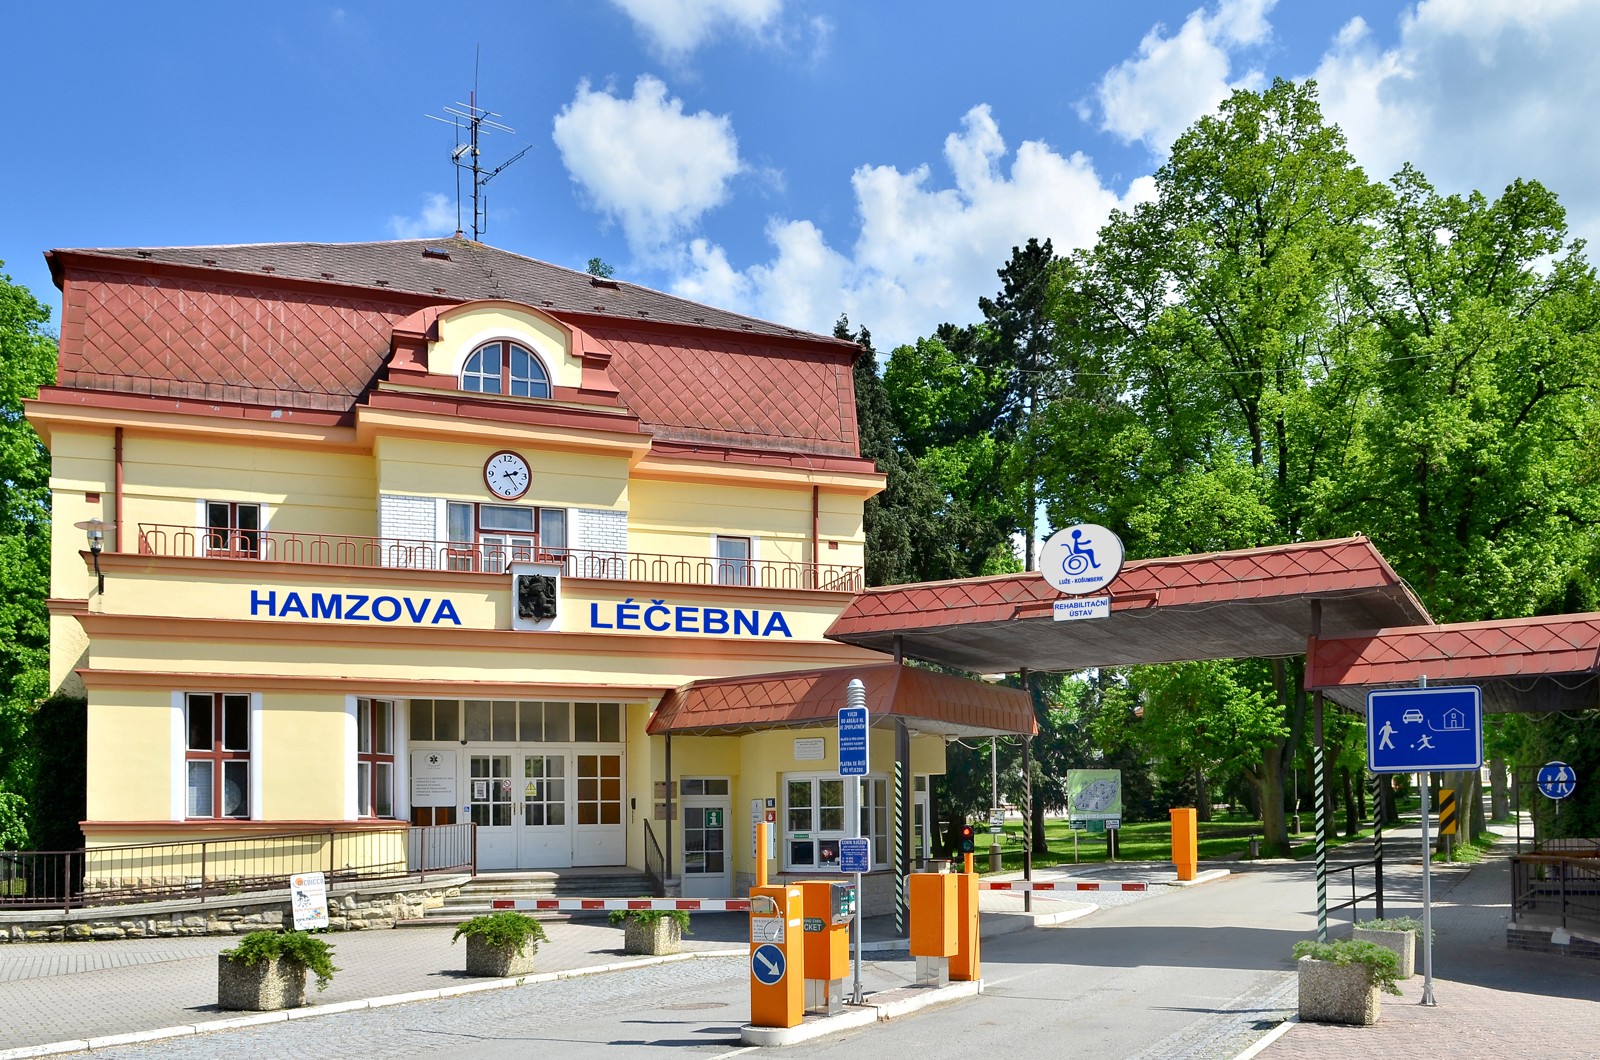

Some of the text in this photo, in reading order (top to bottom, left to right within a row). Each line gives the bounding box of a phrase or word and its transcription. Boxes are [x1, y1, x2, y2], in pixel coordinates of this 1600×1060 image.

[1054, 599, 1108, 610] REHABILITAČNÍ
[250, 589, 793, 638] HAMZOVA LÉČEBNA
[1069, 609, 1093, 617] ÚSTAV
[804, 923, 822, 931] CKET
